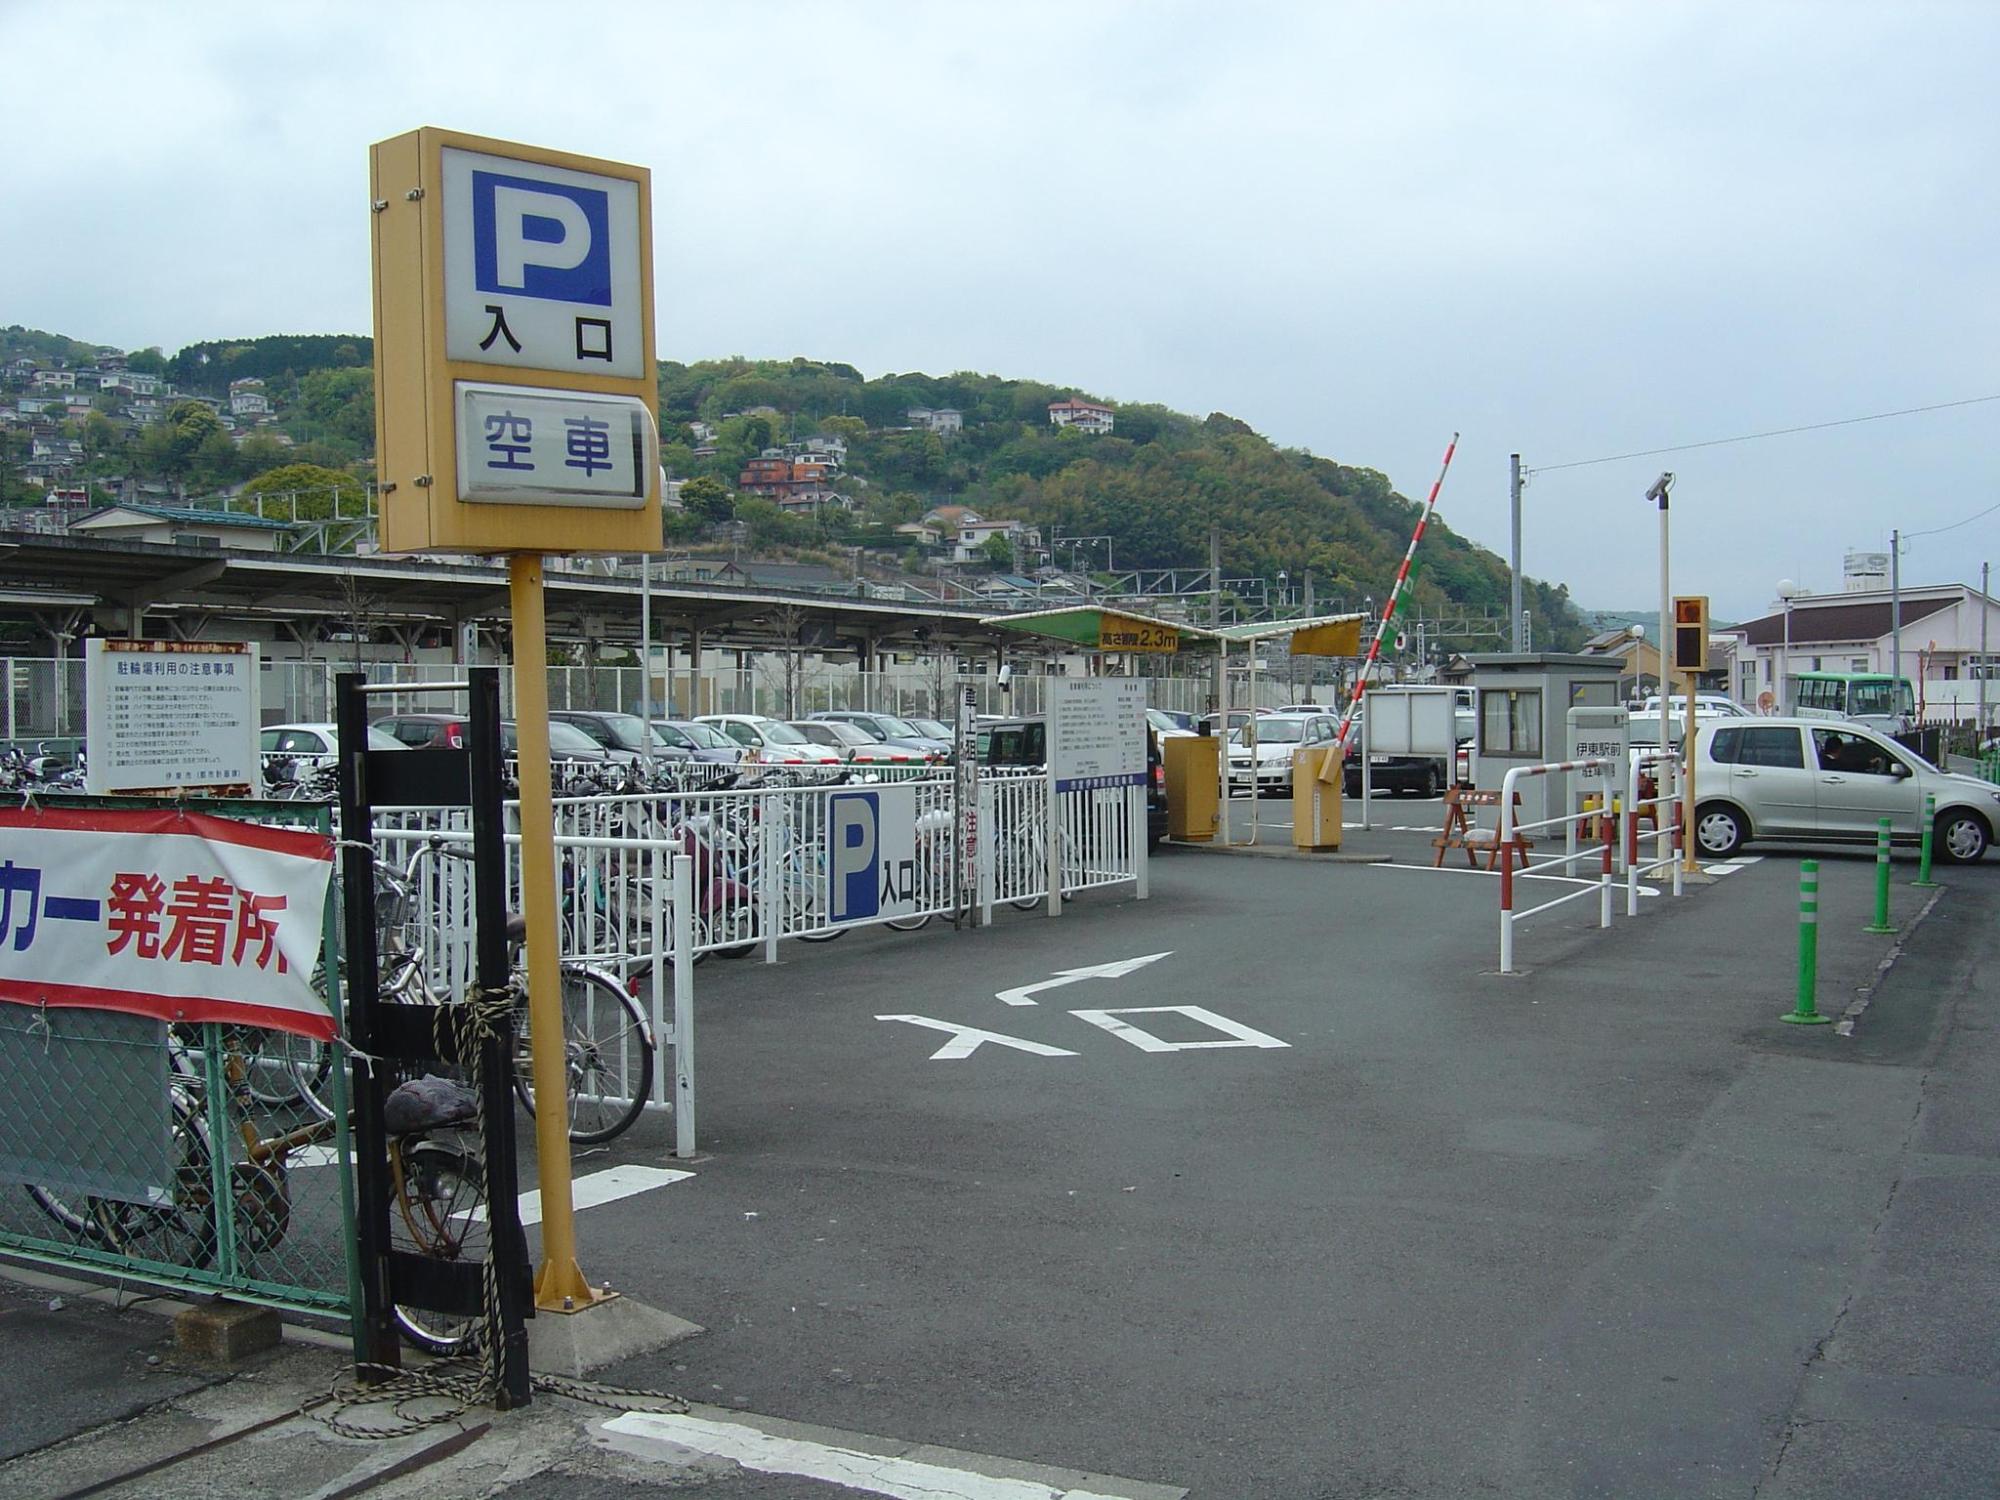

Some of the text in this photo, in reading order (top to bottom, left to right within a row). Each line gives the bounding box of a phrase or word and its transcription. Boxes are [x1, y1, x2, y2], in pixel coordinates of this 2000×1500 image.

[494, 185, 592, 288] P
[479, 305, 613, 363] 入口
[485, 410, 613, 478] 空車
[117, 661, 235, 676] 駐輪場利用の注意事項
[1576, 742, 1621, 757] 伊東駅前
[833, 797, 876, 917] P
[880, 859, 914, 907] 入口
